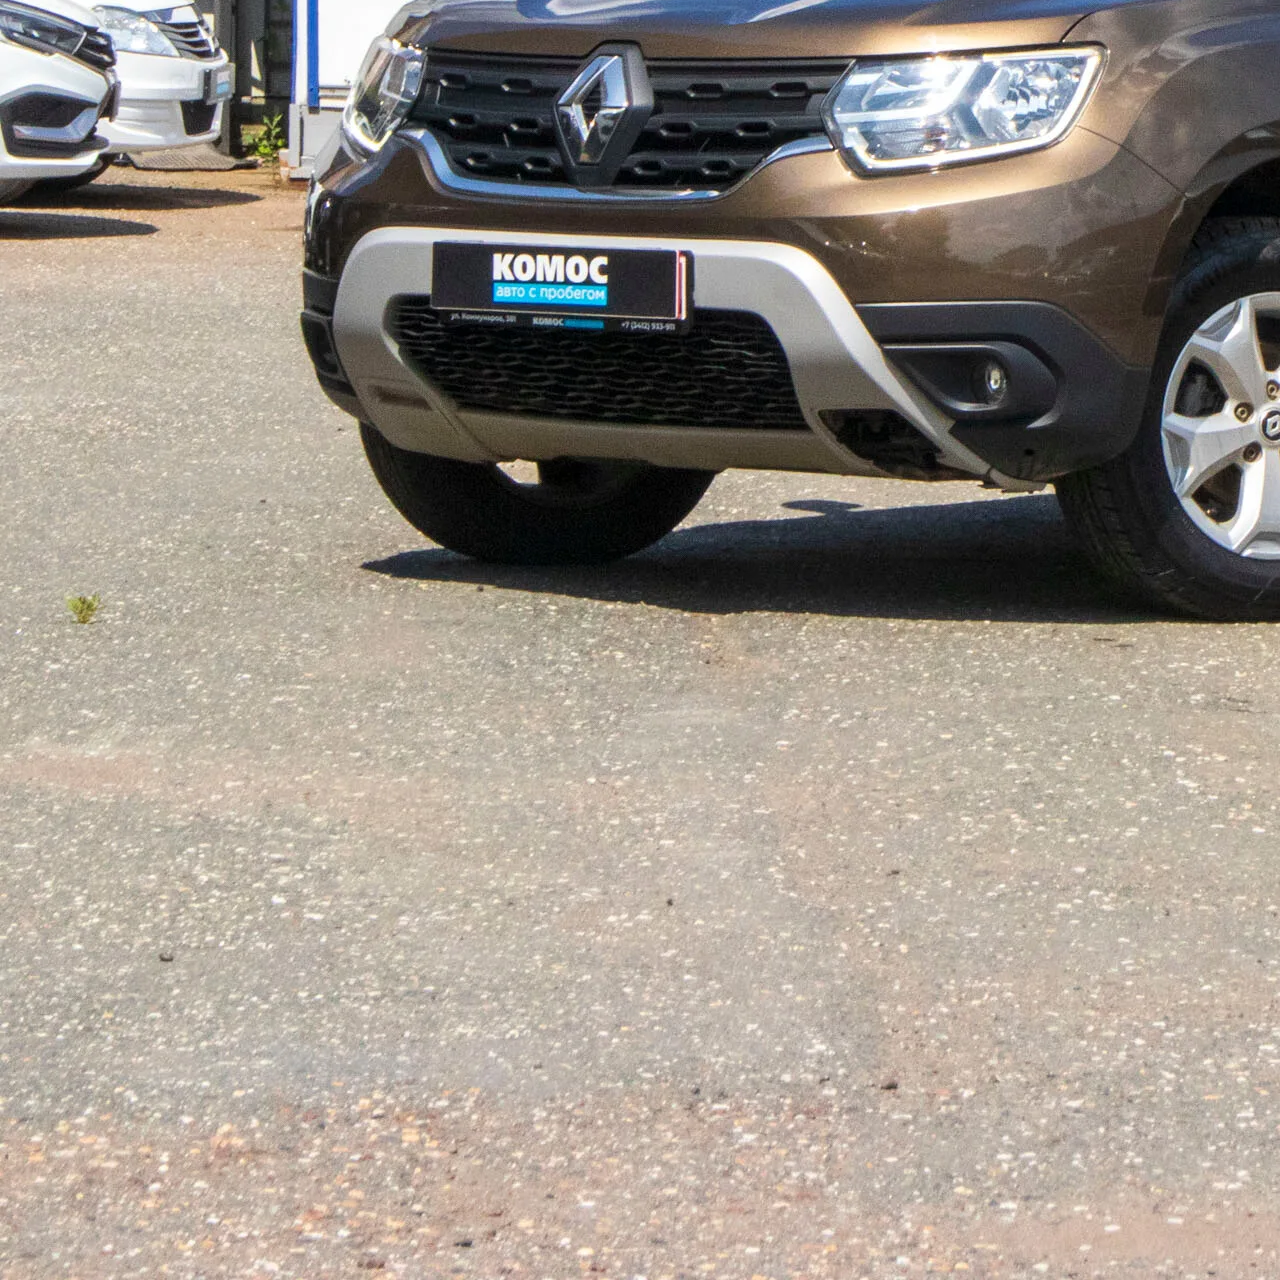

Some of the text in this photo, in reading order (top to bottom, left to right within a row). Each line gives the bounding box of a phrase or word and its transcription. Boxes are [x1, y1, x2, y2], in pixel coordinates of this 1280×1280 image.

[493, 253, 608, 283] КОМОС
[496, 286, 605, 301] авто с пробегом
[532, 316, 564, 326] КОМОС
